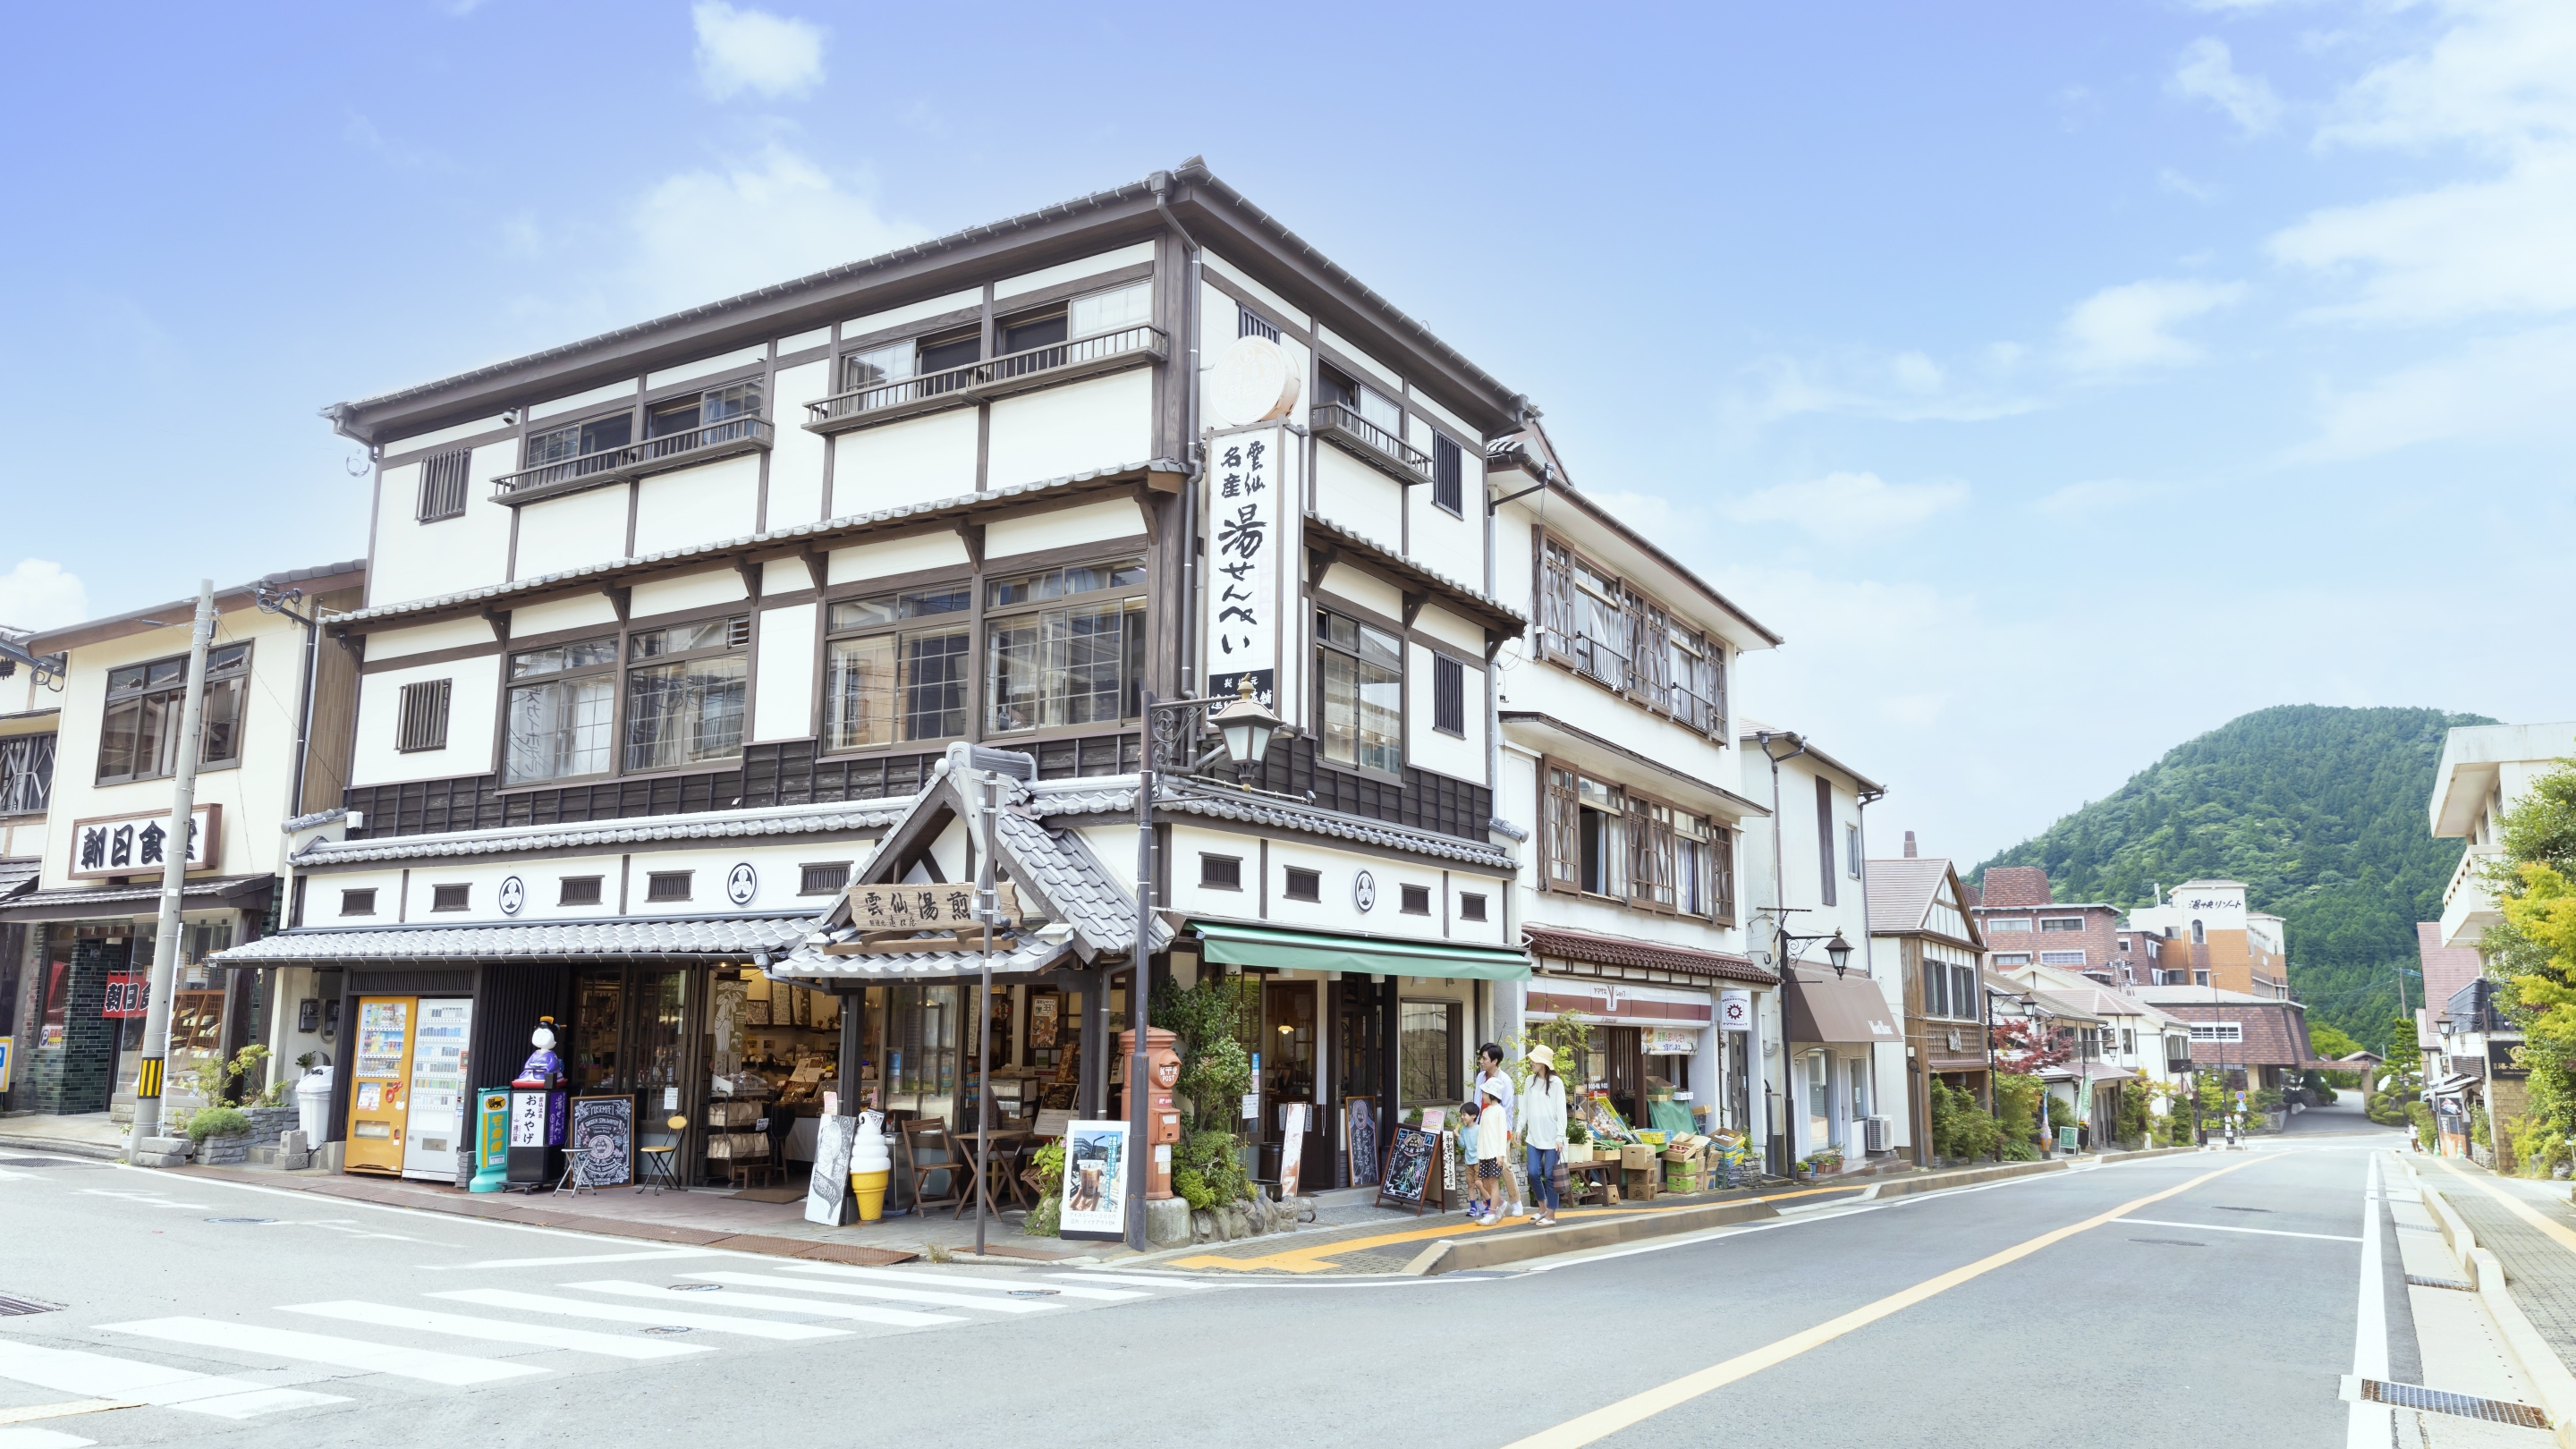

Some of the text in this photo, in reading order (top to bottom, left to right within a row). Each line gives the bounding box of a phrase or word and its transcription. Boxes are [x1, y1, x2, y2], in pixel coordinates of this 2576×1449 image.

[1221, 446, 1241, 498] 名産
[1245, 441, 1266, 496] 雲仙
[865, 892, 971, 921] 雲仙湯煎
[2189, 899, 2241, 910] 湯快リゾート
[105, 983, 152, 1013] 朝日食
[490, 1114, 504, 1153] 宅急便
[523, 1095, 537, 1145] おみやげ
